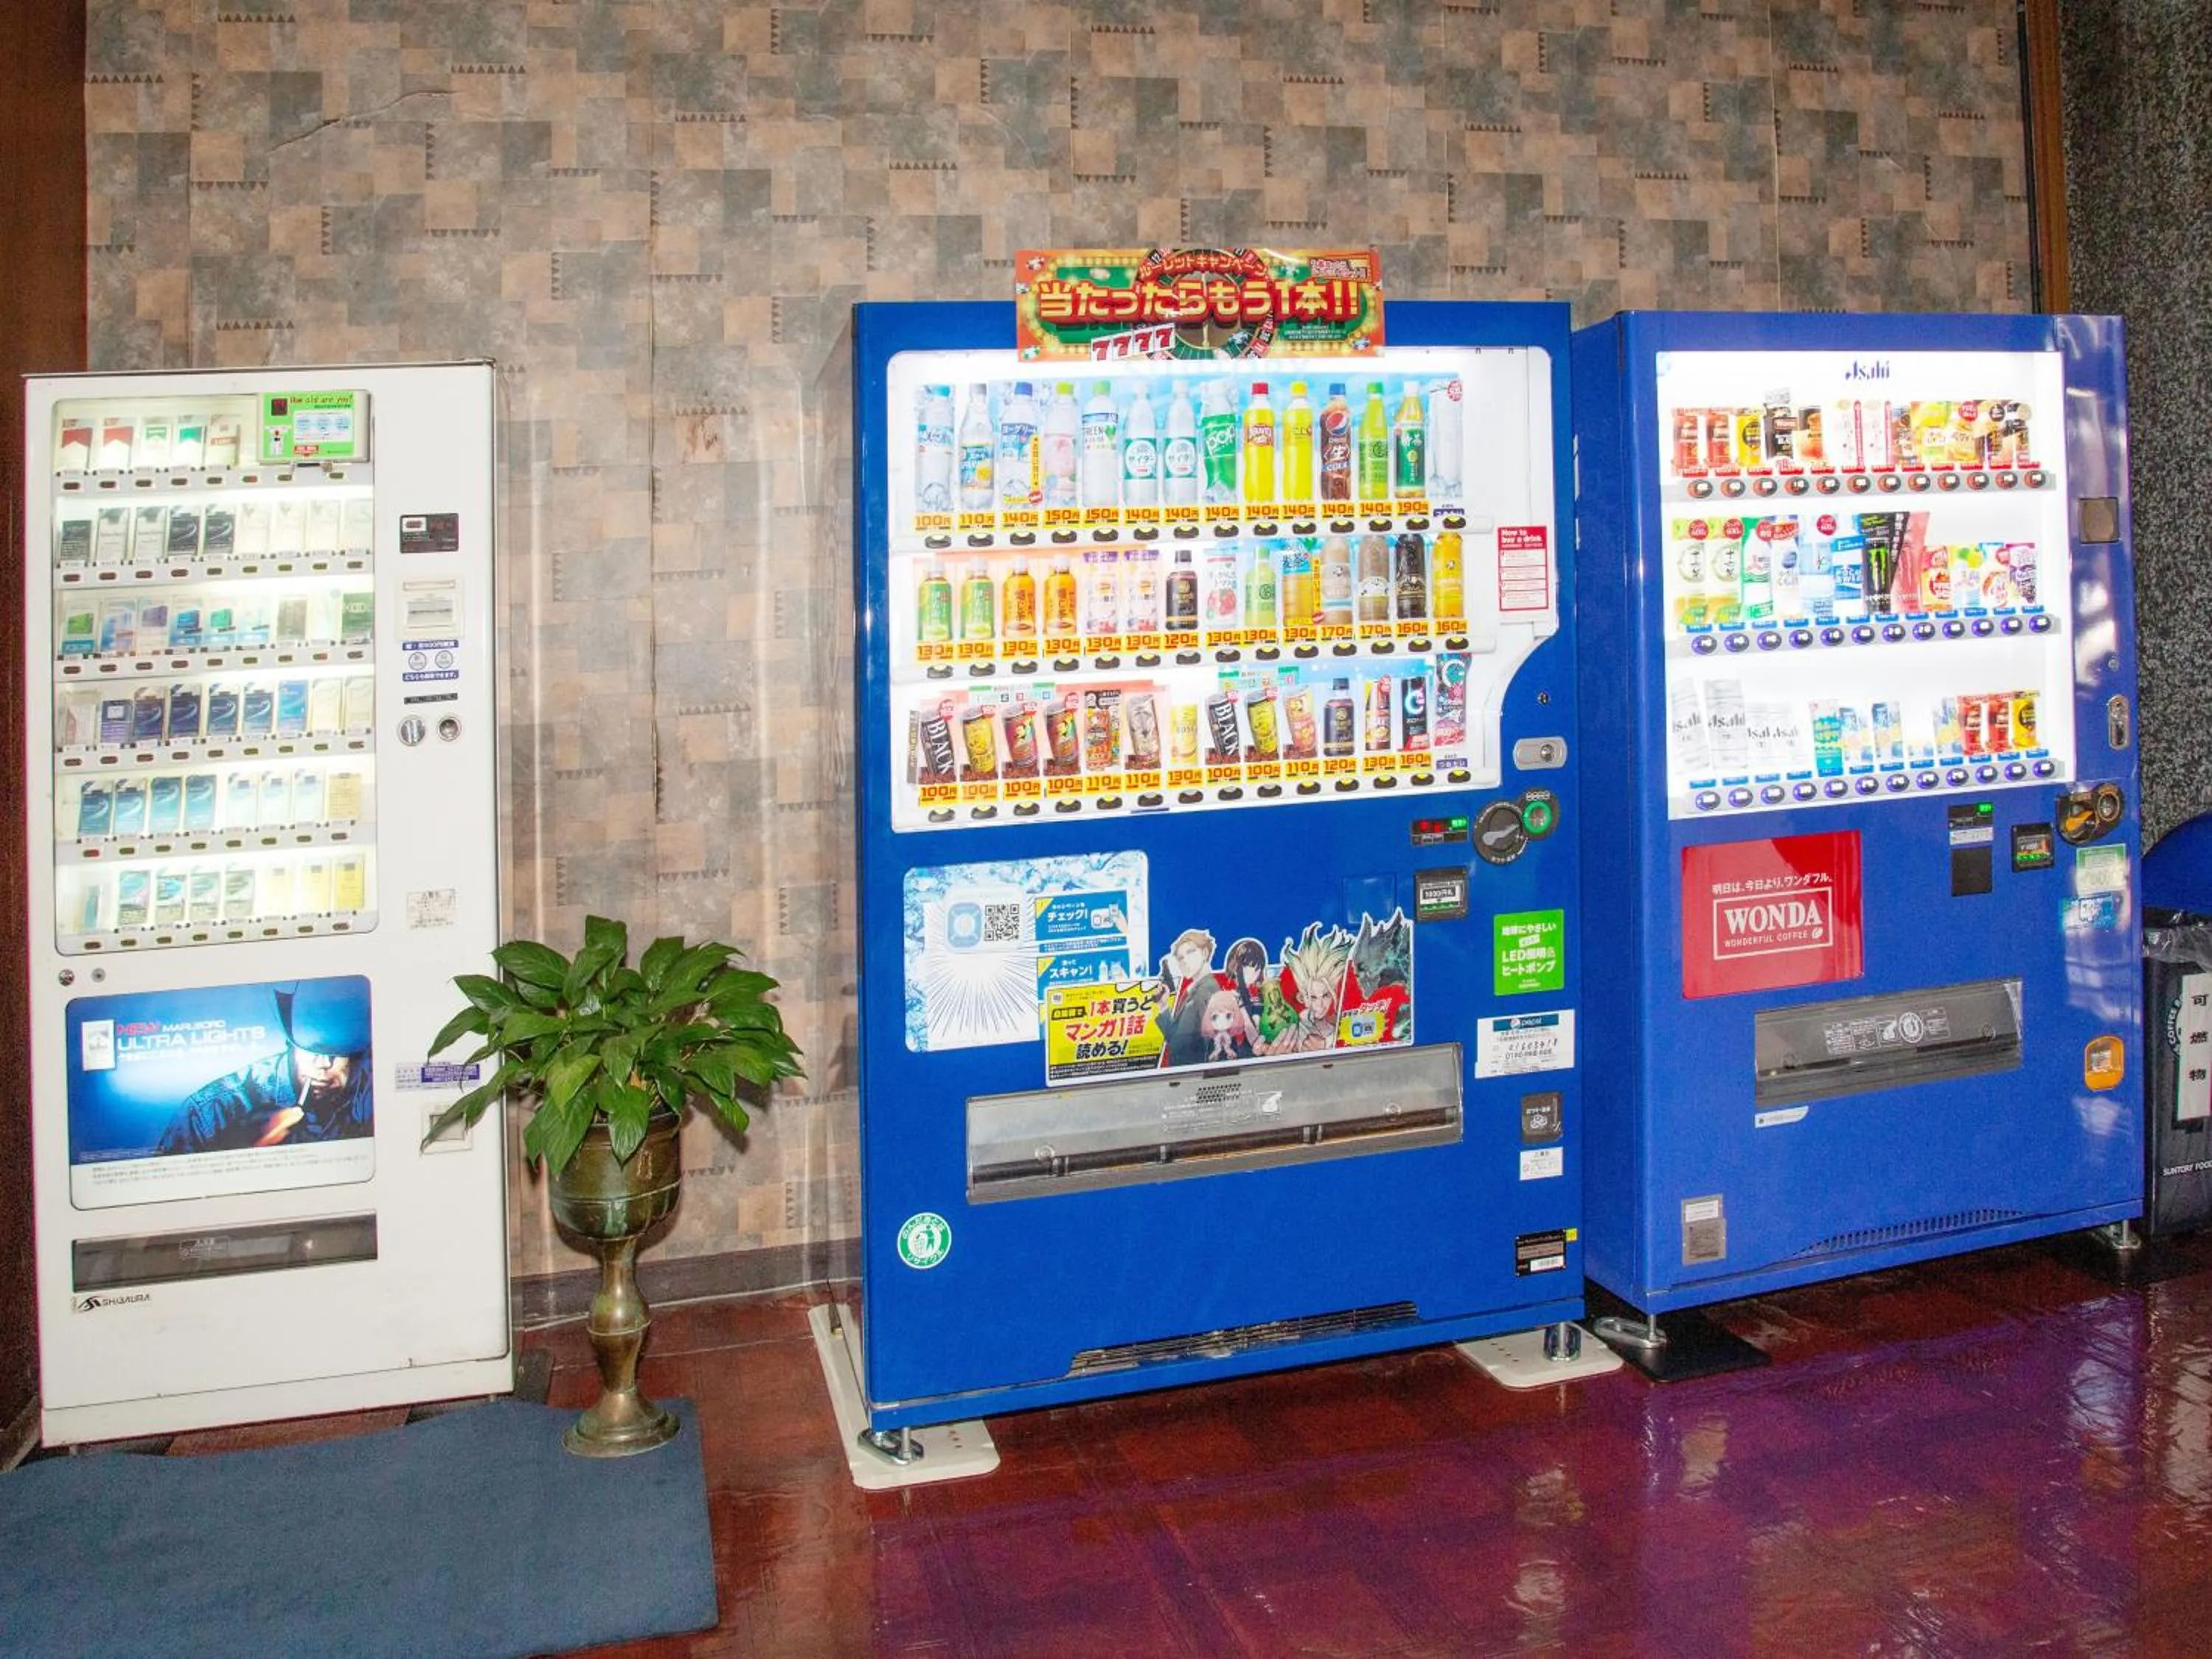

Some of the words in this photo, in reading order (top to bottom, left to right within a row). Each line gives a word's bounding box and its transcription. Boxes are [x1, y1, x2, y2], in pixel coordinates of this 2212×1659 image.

[1040, 280, 1358, 317] 当たったらもう1本!!
[1845, 360, 1890, 380] Asahi
[1215, 703, 1239, 756] BLACK
[927, 719, 954, 774] BLACK
[1047, 908, 1088, 923] チェック!
[1724, 899, 1823, 936] WONDA
[1724, 935, 1774, 947] WONDERFUL
[1776, 931, 1809, 942] COFFEE
[1049, 964, 1093, 978] スキャン!
[1091, 995, 1152, 1017] 1本買うと
[117, 1021, 161, 1036] NEW
[161, 1020, 227, 1033] MARLBORO
[117, 1032, 187, 1051] ULTRA
[189, 1025, 266, 1046] LIGHTS
[1065, 1015, 1146, 1041] マンガ1話
[1076, 1039, 1128, 1060] 読める!
[2163, 1164, 2194, 1176] SUNTORY
[102, 1294, 150, 1307] SHIBAURA
